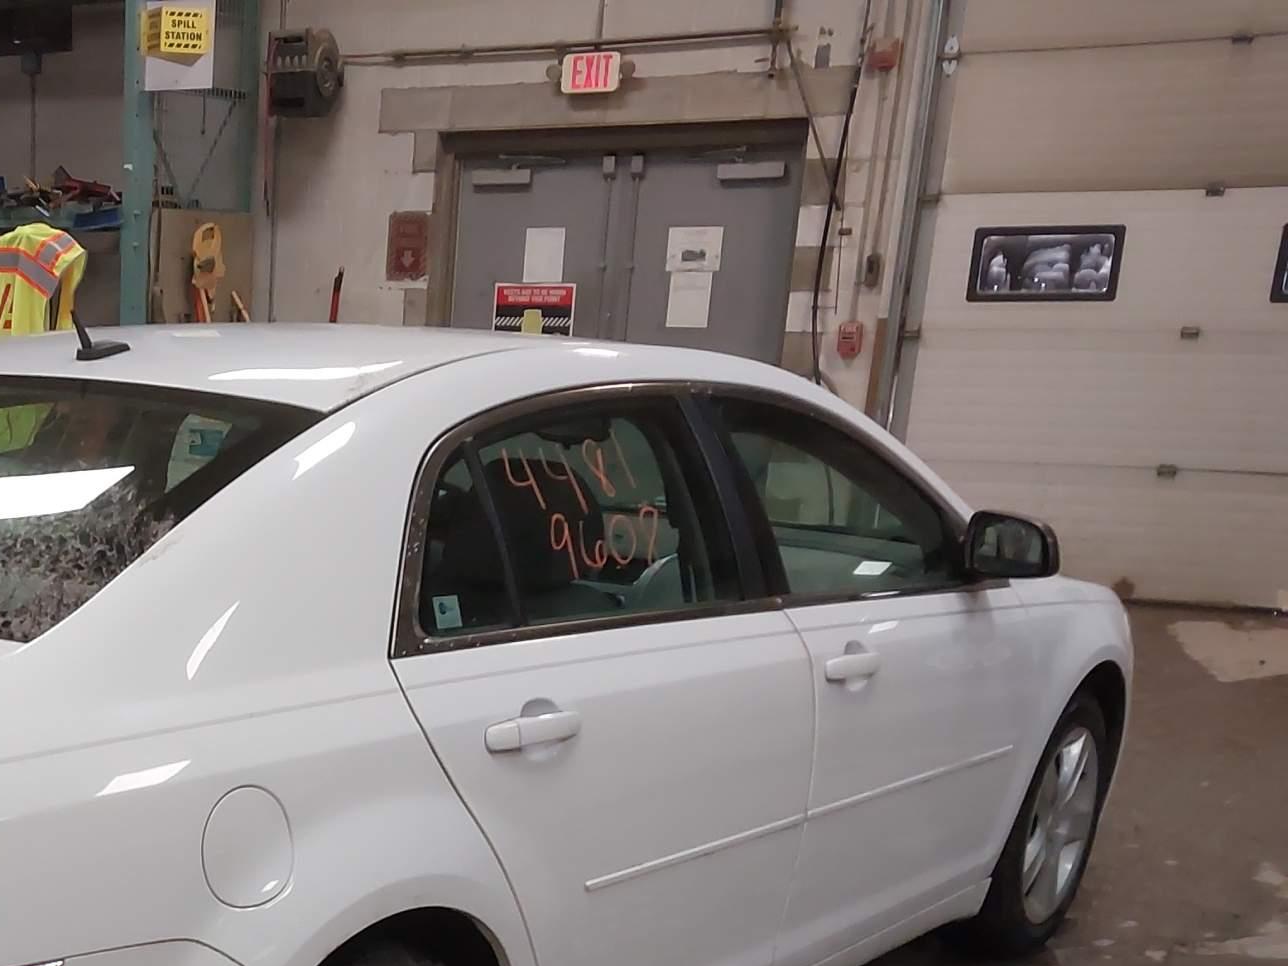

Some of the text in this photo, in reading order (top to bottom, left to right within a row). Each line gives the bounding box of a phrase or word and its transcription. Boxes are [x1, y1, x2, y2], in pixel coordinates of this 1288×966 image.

[171, 18, 197, 29] SPILL
[164, 30, 202, 41] STATION
[571, 54, 613, 89] EXIT
